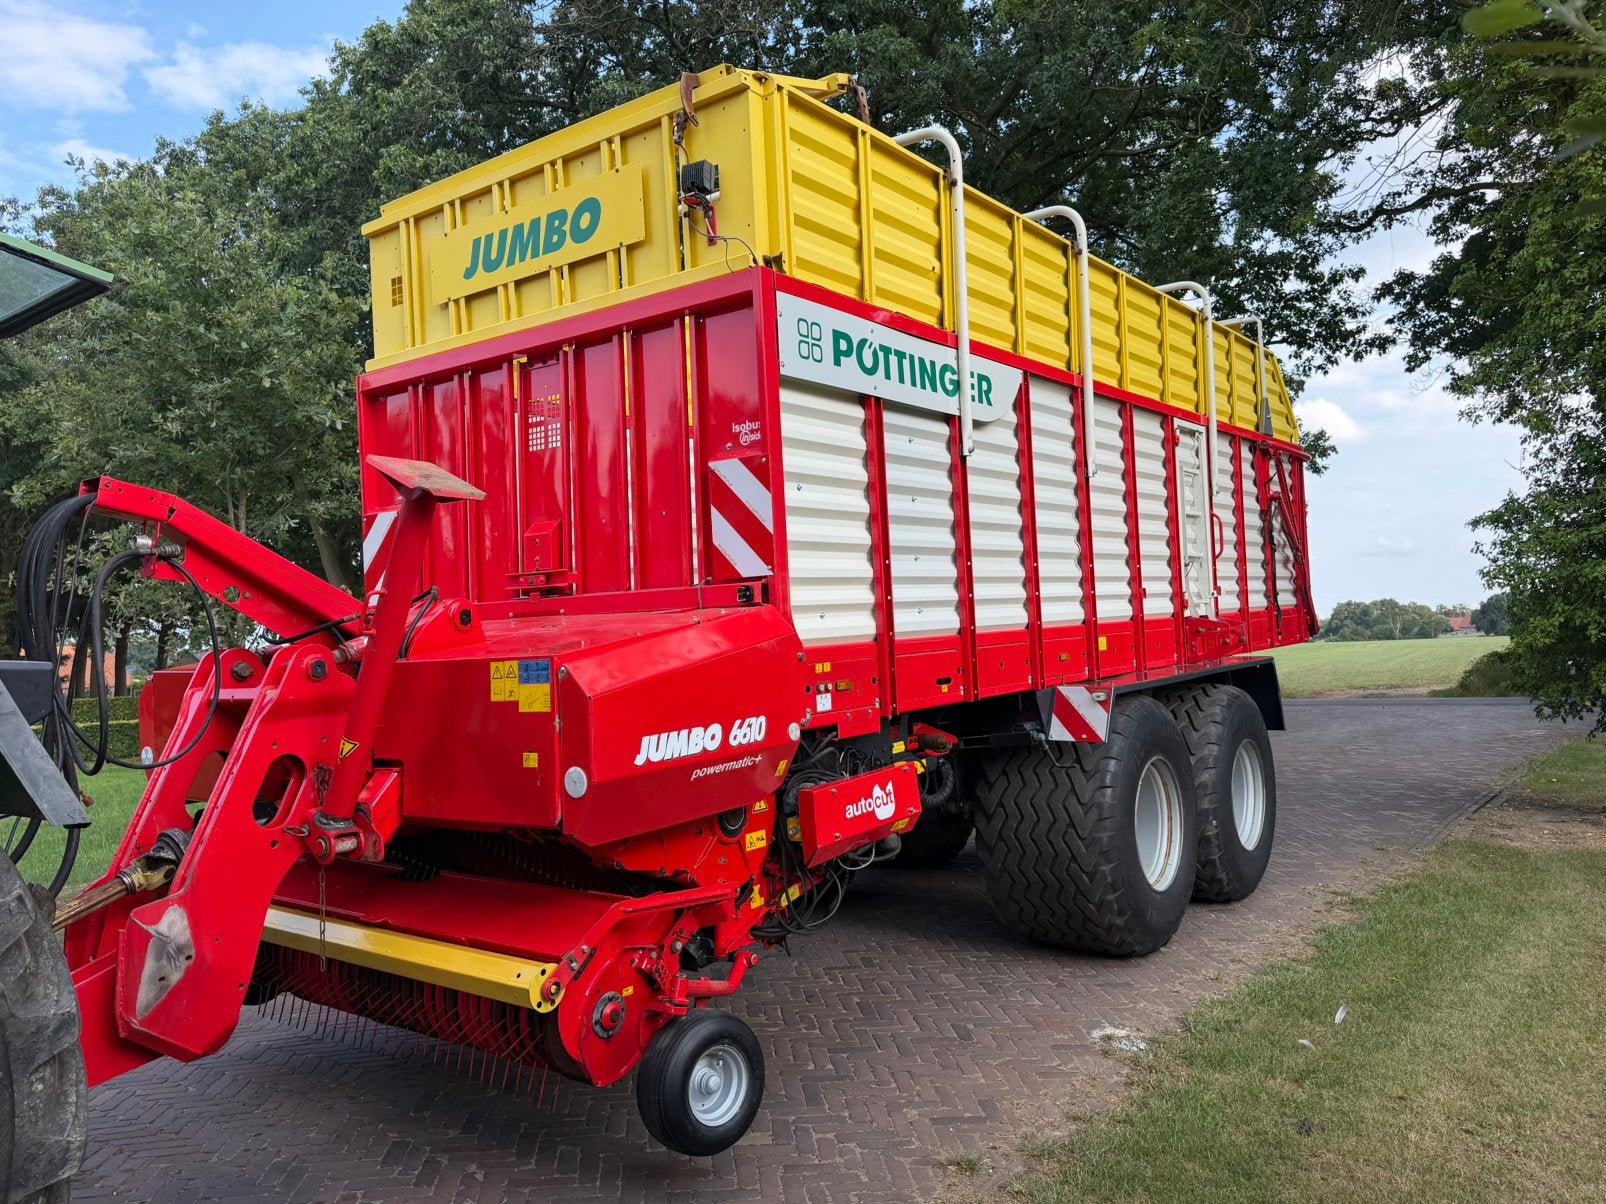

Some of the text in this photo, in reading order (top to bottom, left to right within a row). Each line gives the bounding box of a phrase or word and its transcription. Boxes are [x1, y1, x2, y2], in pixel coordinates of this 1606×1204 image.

[463, 197, 601, 281] JUMBO
[634, 715, 767, 766] JUMBO 6610
[690, 753, 763, 781] powermatic+
